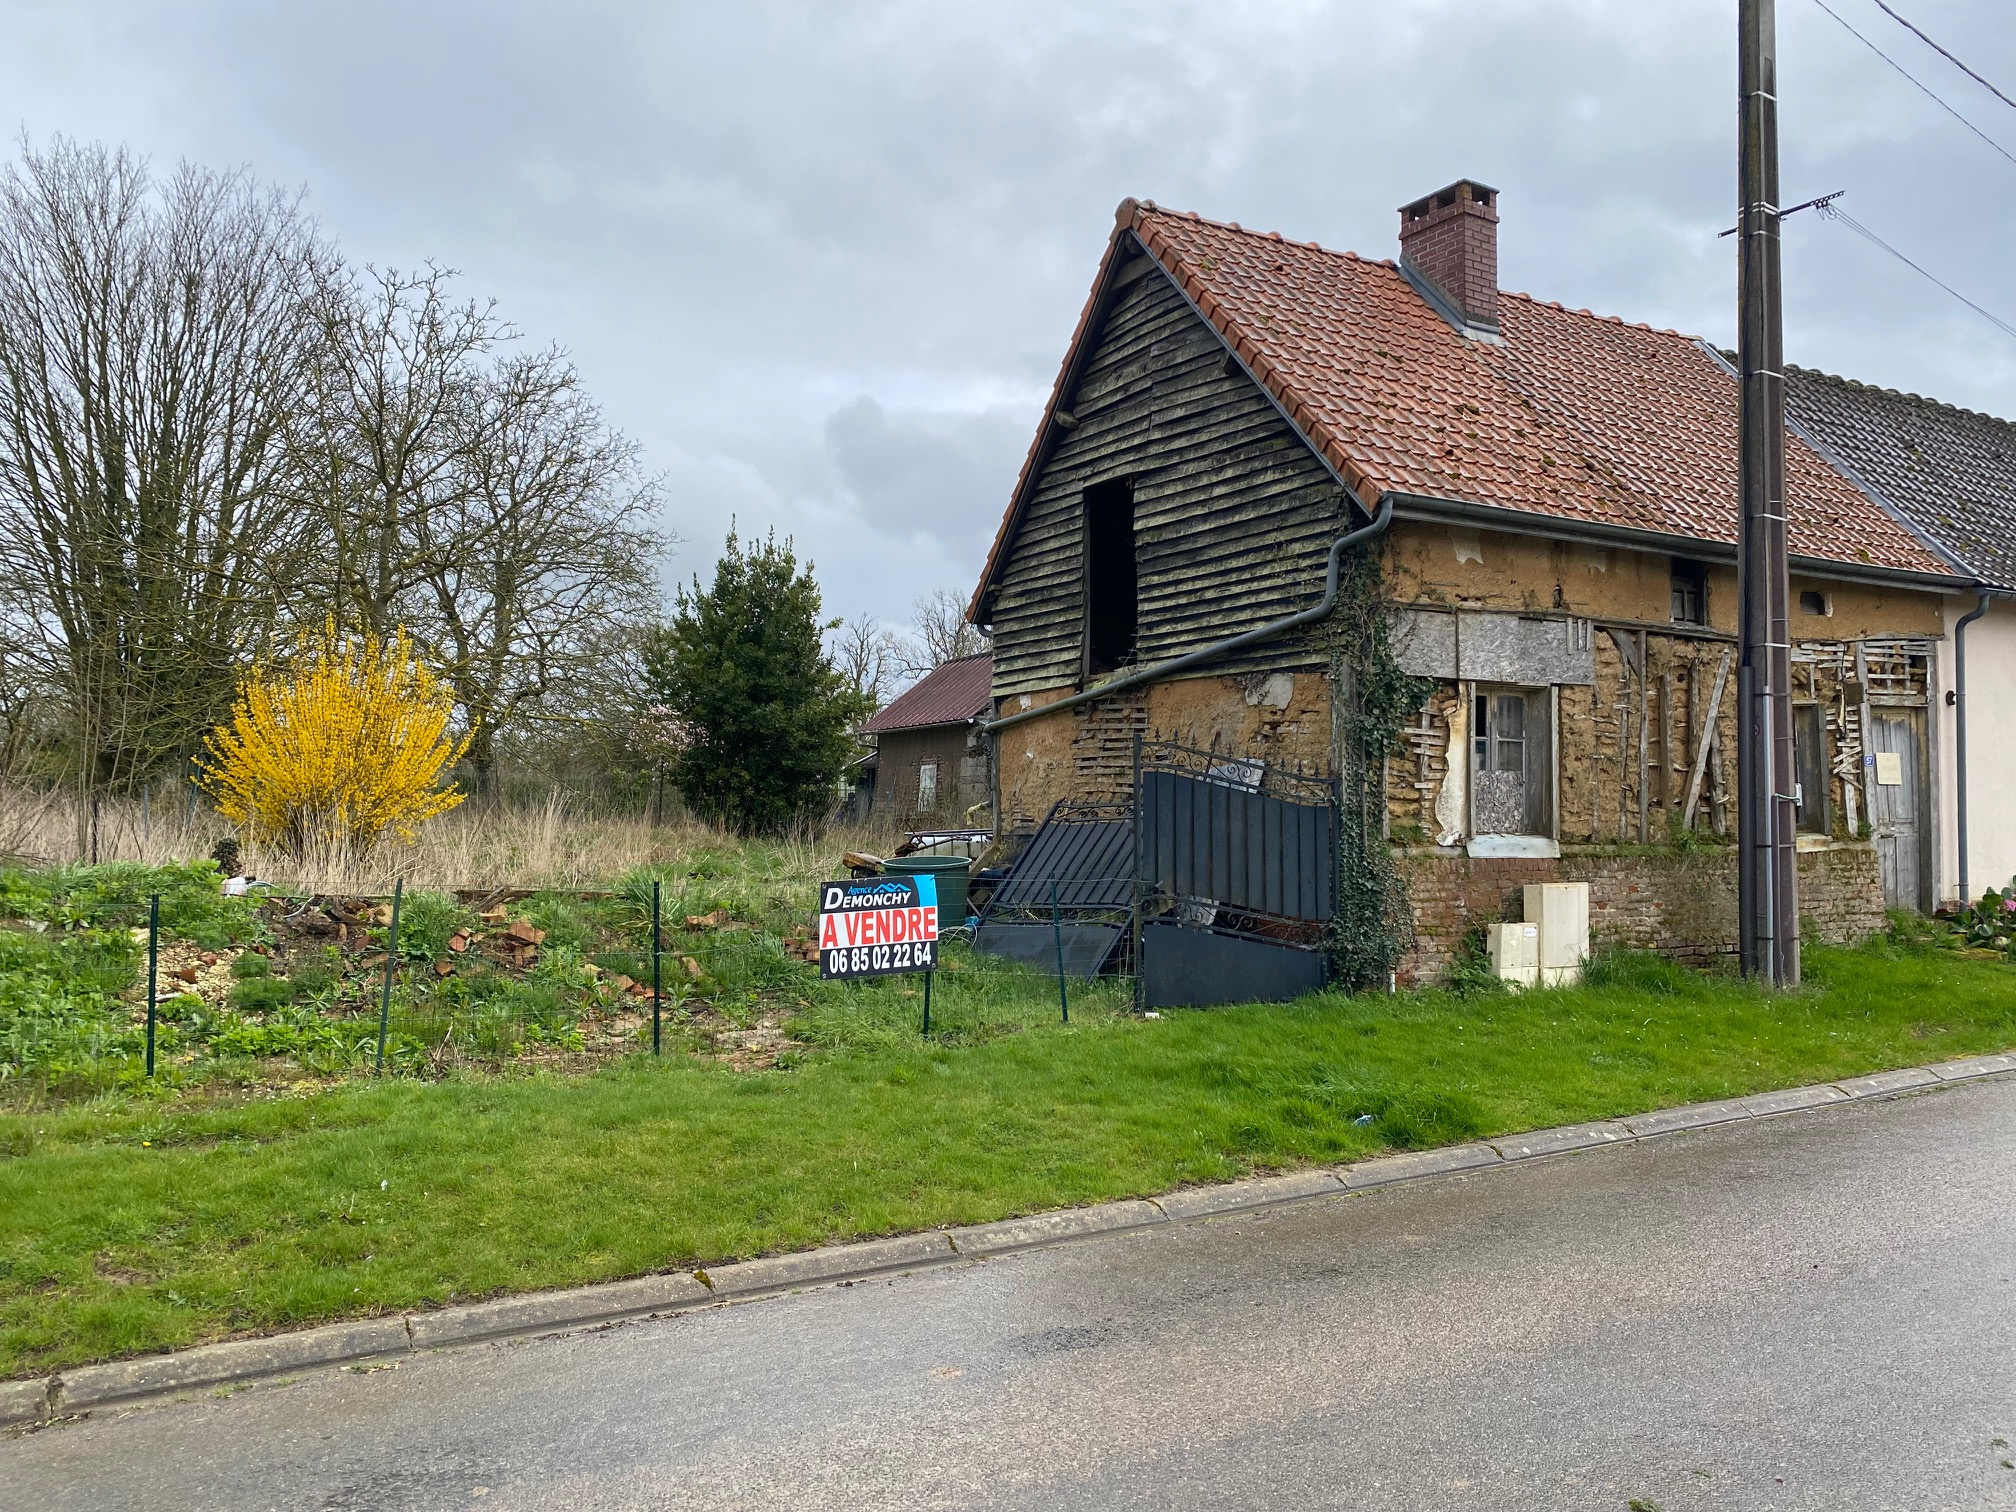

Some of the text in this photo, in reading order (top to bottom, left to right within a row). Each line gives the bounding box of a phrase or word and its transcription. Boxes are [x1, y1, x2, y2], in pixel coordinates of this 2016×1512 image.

[824, 888, 911, 909] DEMONCHY
[848, 886, 871, 895] Agence
[822, 907, 936, 948] A VENDRE
[830, 942, 931, 974] 06 85 02 22 64
